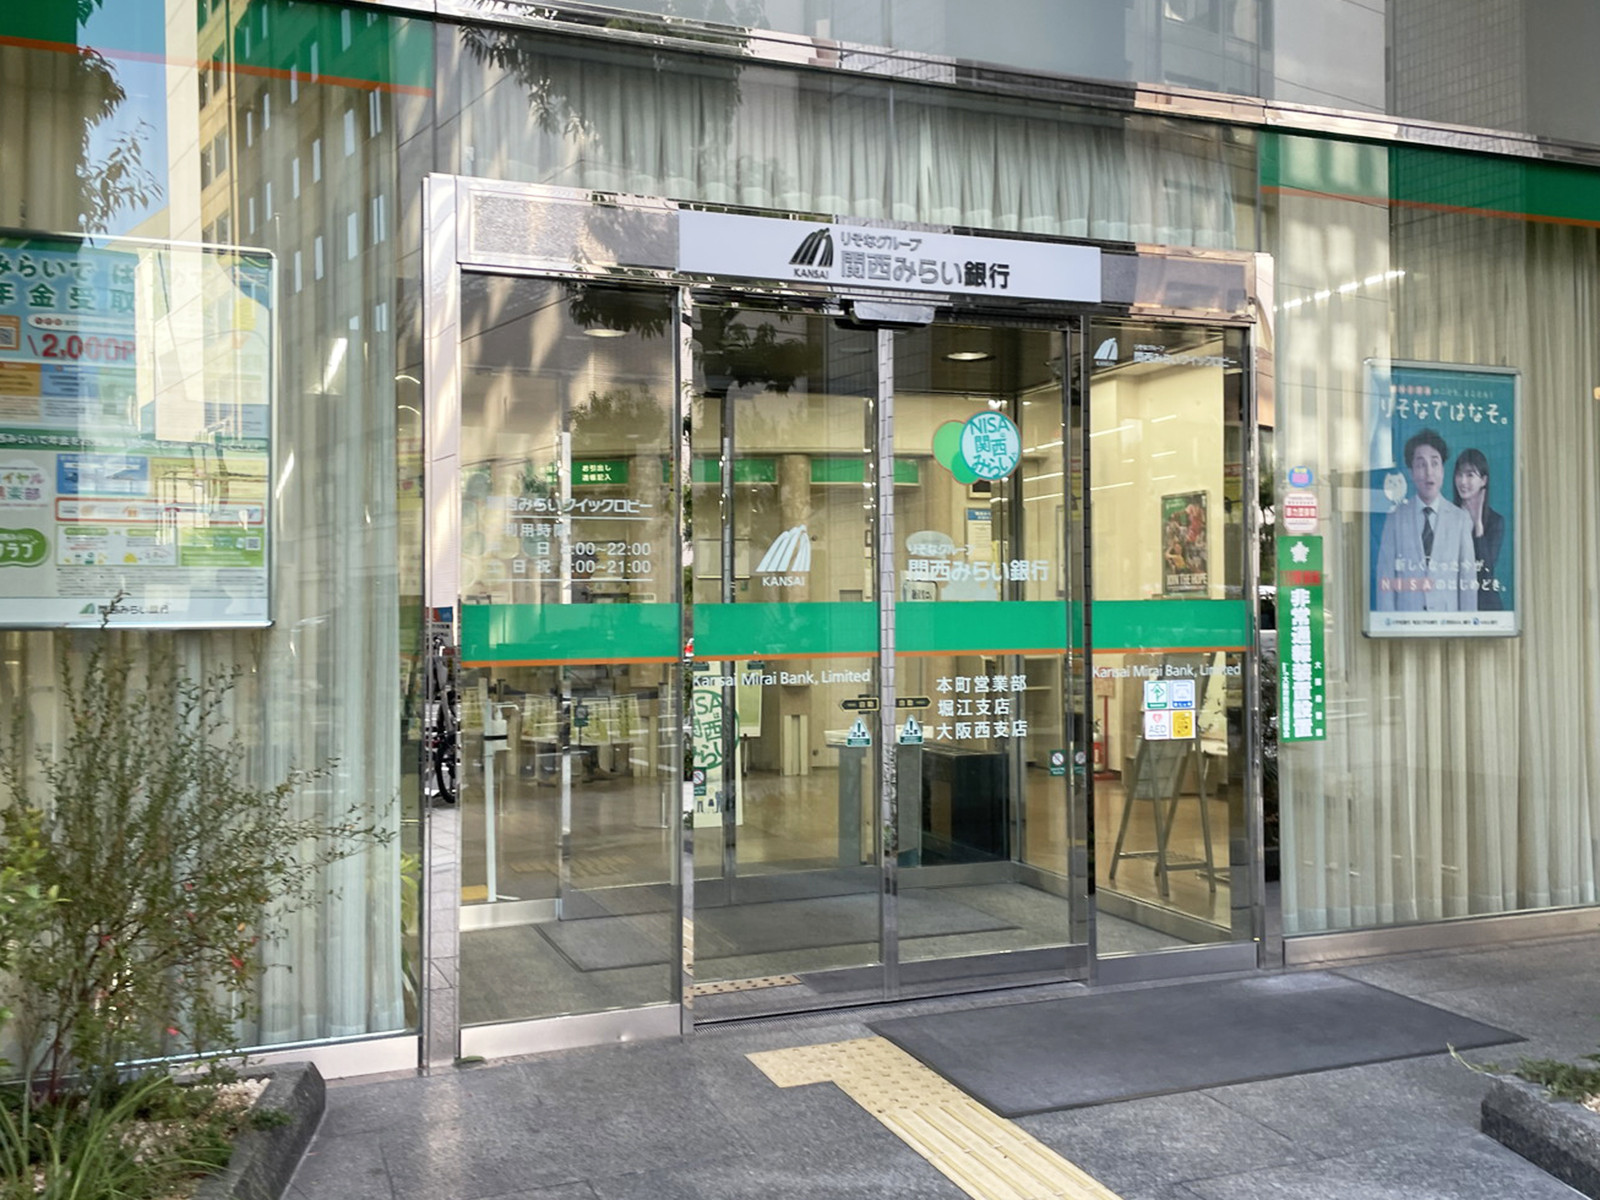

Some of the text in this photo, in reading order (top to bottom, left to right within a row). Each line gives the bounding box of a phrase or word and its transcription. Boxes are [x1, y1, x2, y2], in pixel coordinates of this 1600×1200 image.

[841, 231, 922, 252] りそなグループ
[793, 268, 829, 280] KANSAI
[841, 250, 1011, 289] 関西みらい銀行
[970, 416, 1010, 435] NISA
[975, 434, 1007, 456] 関西
[972, 454, 1017, 478] みらい
[561, 542, 651, 556] :00~22:00
[561, 560, 651, 573] :00~21:00
[908, 559, 1050, 582] 関西みらい銀行
[762, 577, 805, 587] KANSAI
[694, 669, 871, 687] Kansai Mirai Bank, Limited
[1093, 665, 1130, 678] Kansai
[1133, 664, 1163, 678] Mirai
[1165, 663, 1198, 678] Bank,
[936, 675, 1028, 695] 本町営業部
[937, 698, 1011, 717] 堀江支店
[936, 720, 1028, 741] 大阪西支店
[1148, 725, 1167, 734] AED
